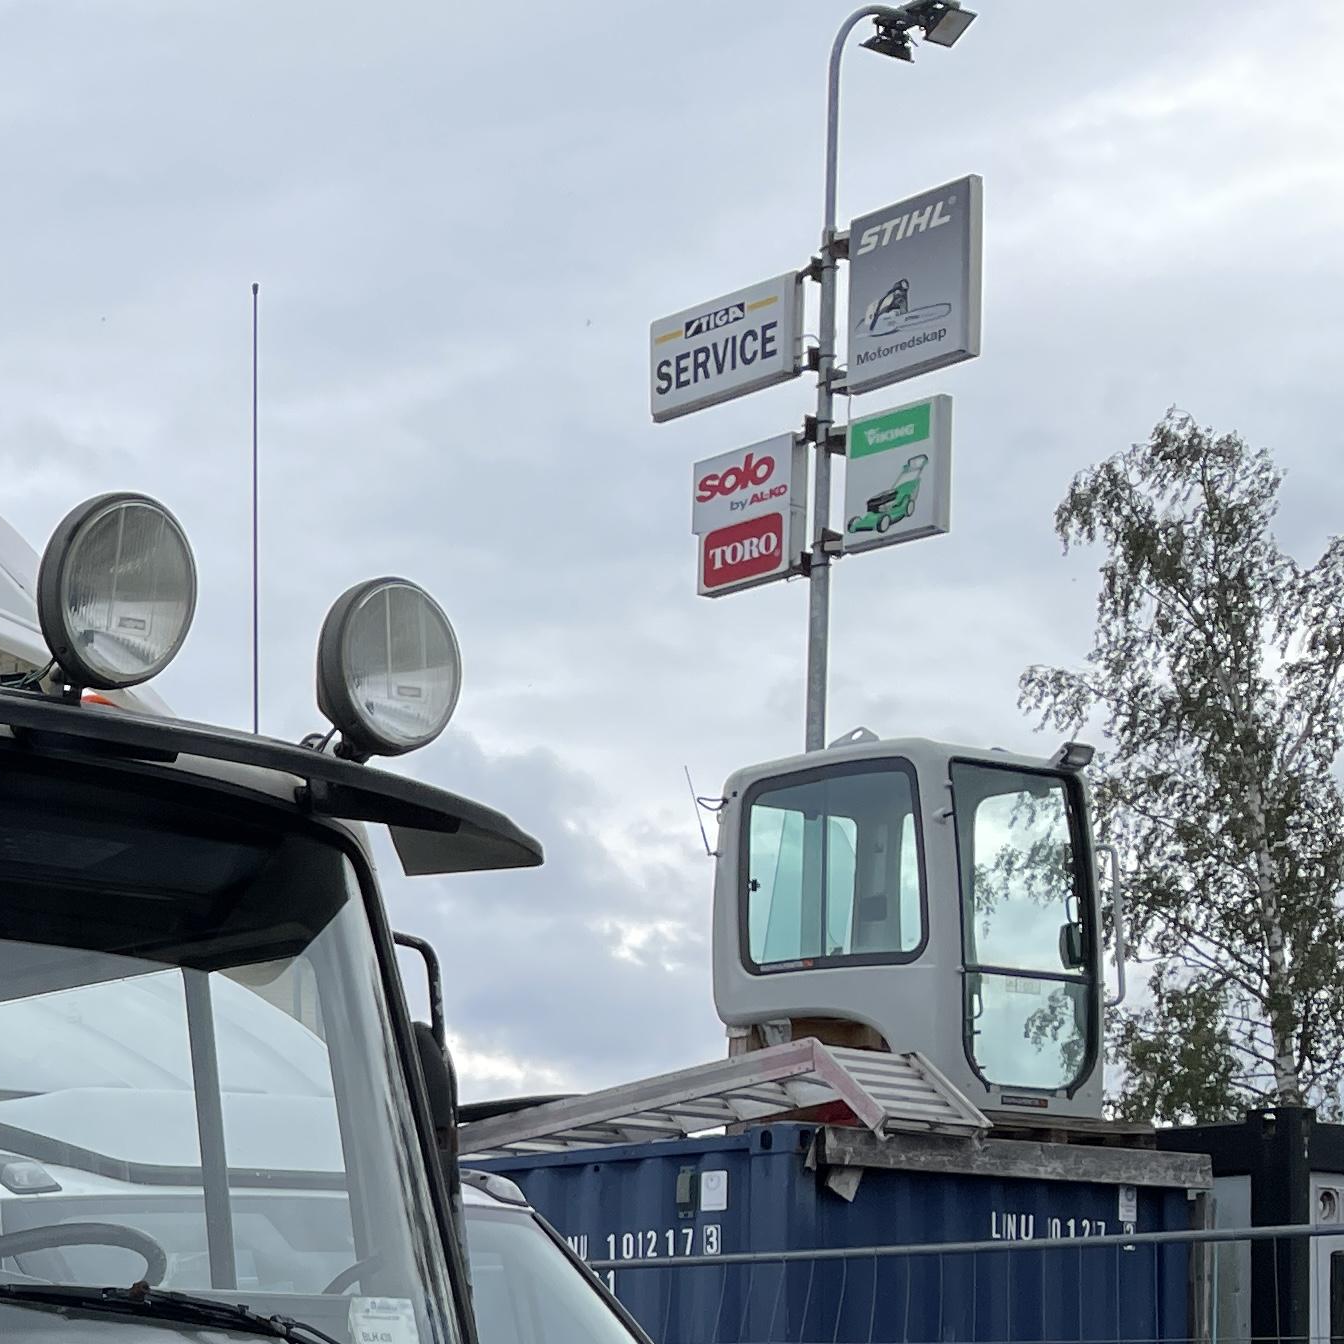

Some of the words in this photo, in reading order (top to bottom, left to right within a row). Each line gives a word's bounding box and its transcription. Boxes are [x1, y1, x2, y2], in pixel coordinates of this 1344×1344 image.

[857, 201, 951, 255] STIHL
[685, 304, 744, 338] STIGA
[656, 321, 777, 395] SERVICE
[857, 328, 946, 366] Motorredskap
[864, 424, 914, 446] VIKING
[730, 500, 749, 511] by
[749, 484, 788, 505] AL-KO
[710, 532, 777, 570] TORO
[607, 1228, 694, 1260] 101217
[704, 1225, 721, 1255] 3
